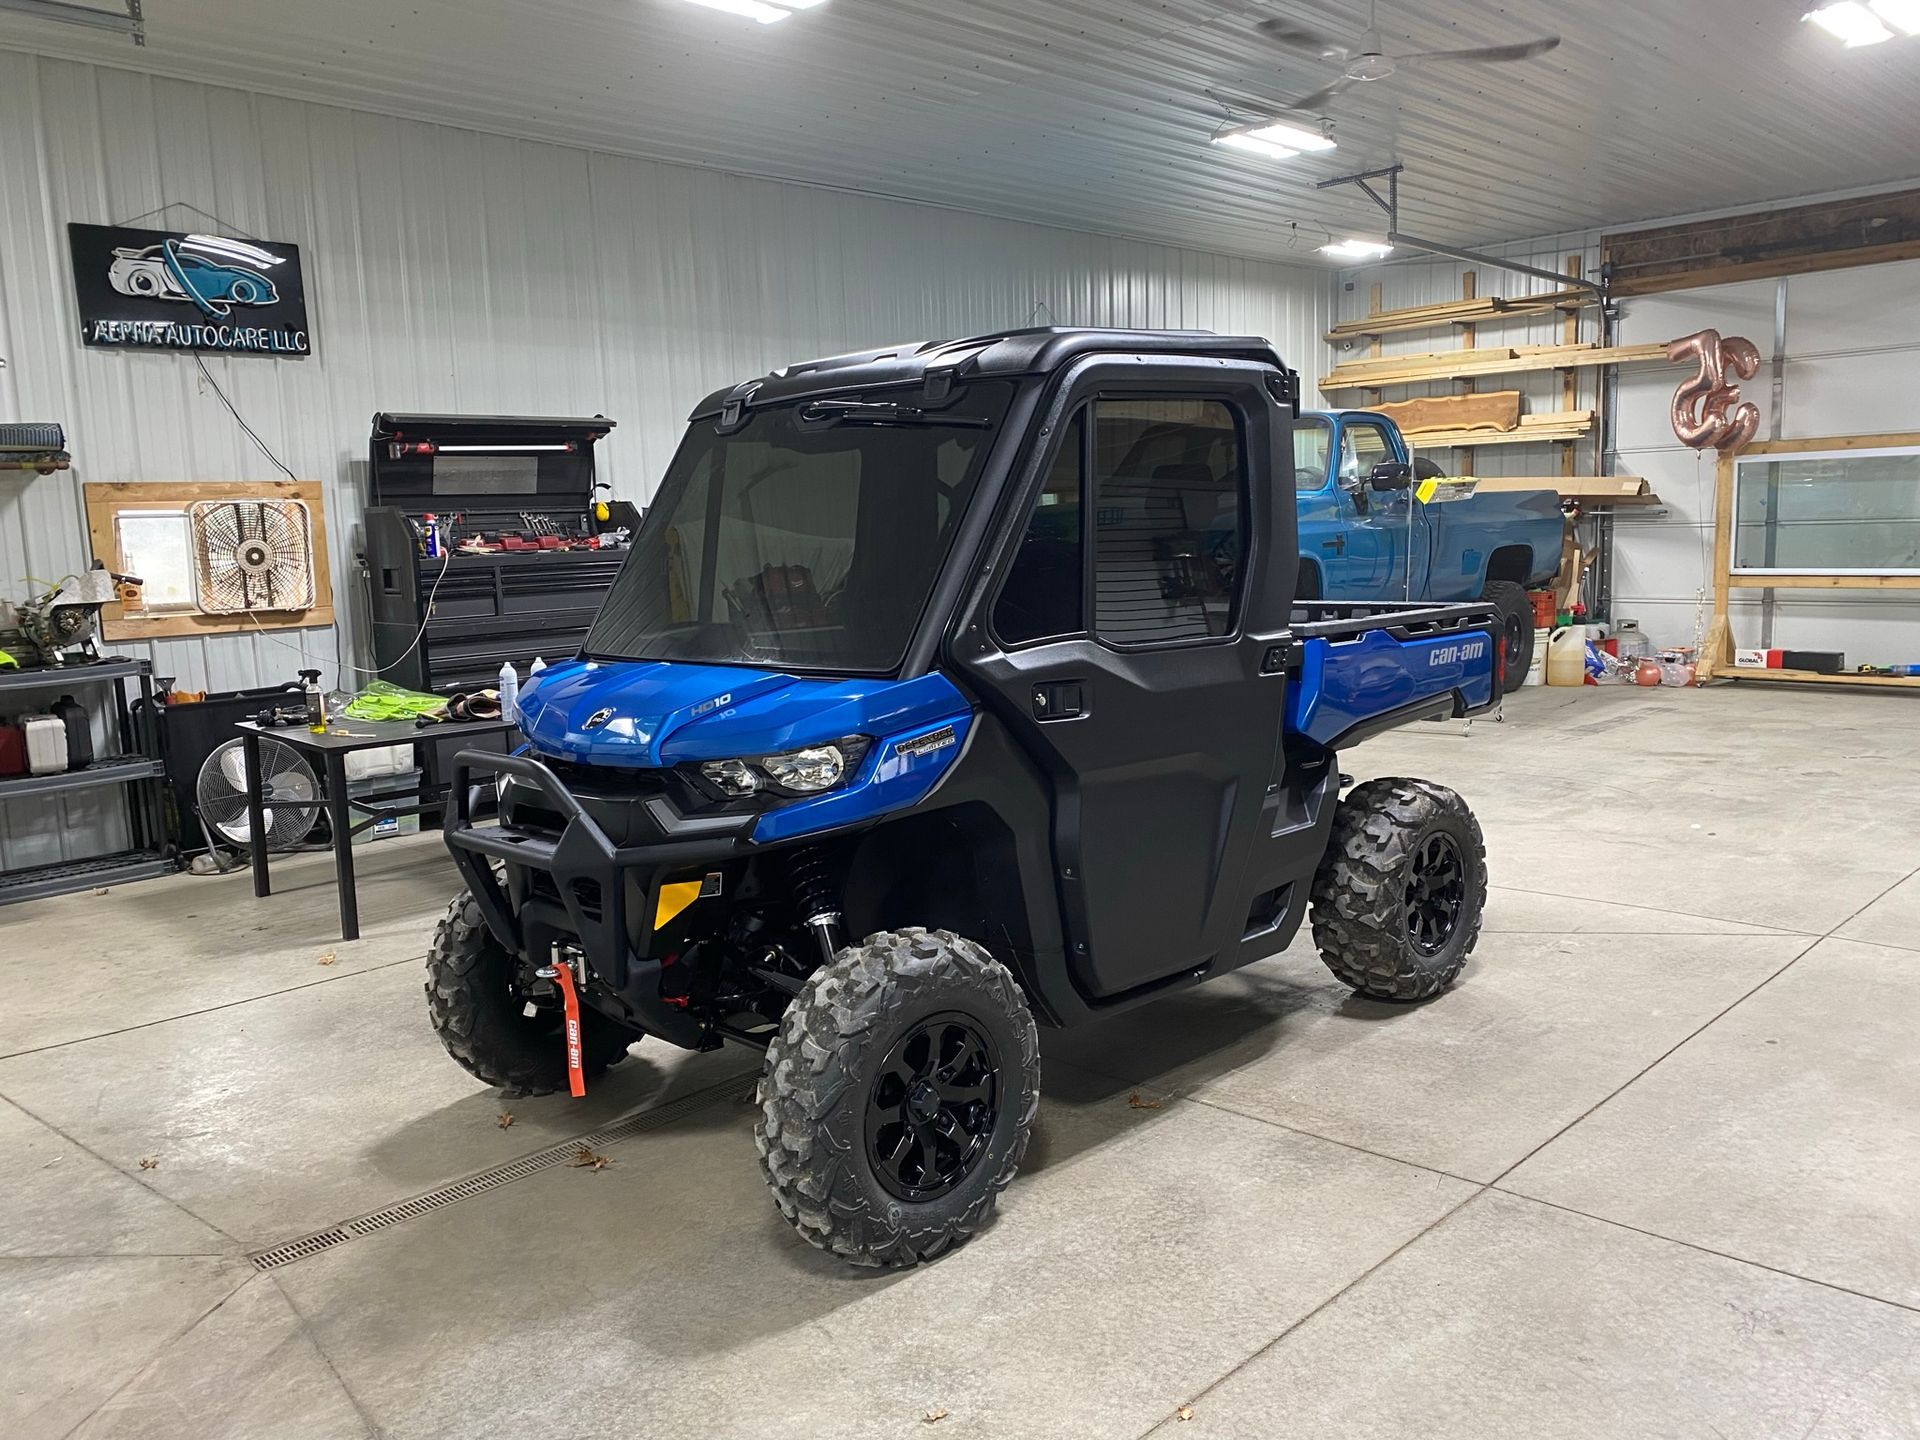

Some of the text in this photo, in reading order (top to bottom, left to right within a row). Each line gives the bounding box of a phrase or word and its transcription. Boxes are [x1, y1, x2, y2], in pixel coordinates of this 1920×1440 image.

[273, 329, 308, 351] LLC
[1429, 642, 1484, 667] can-am
[690, 693, 732, 717] HD10
[568, 1019, 579, 1069] can-am
